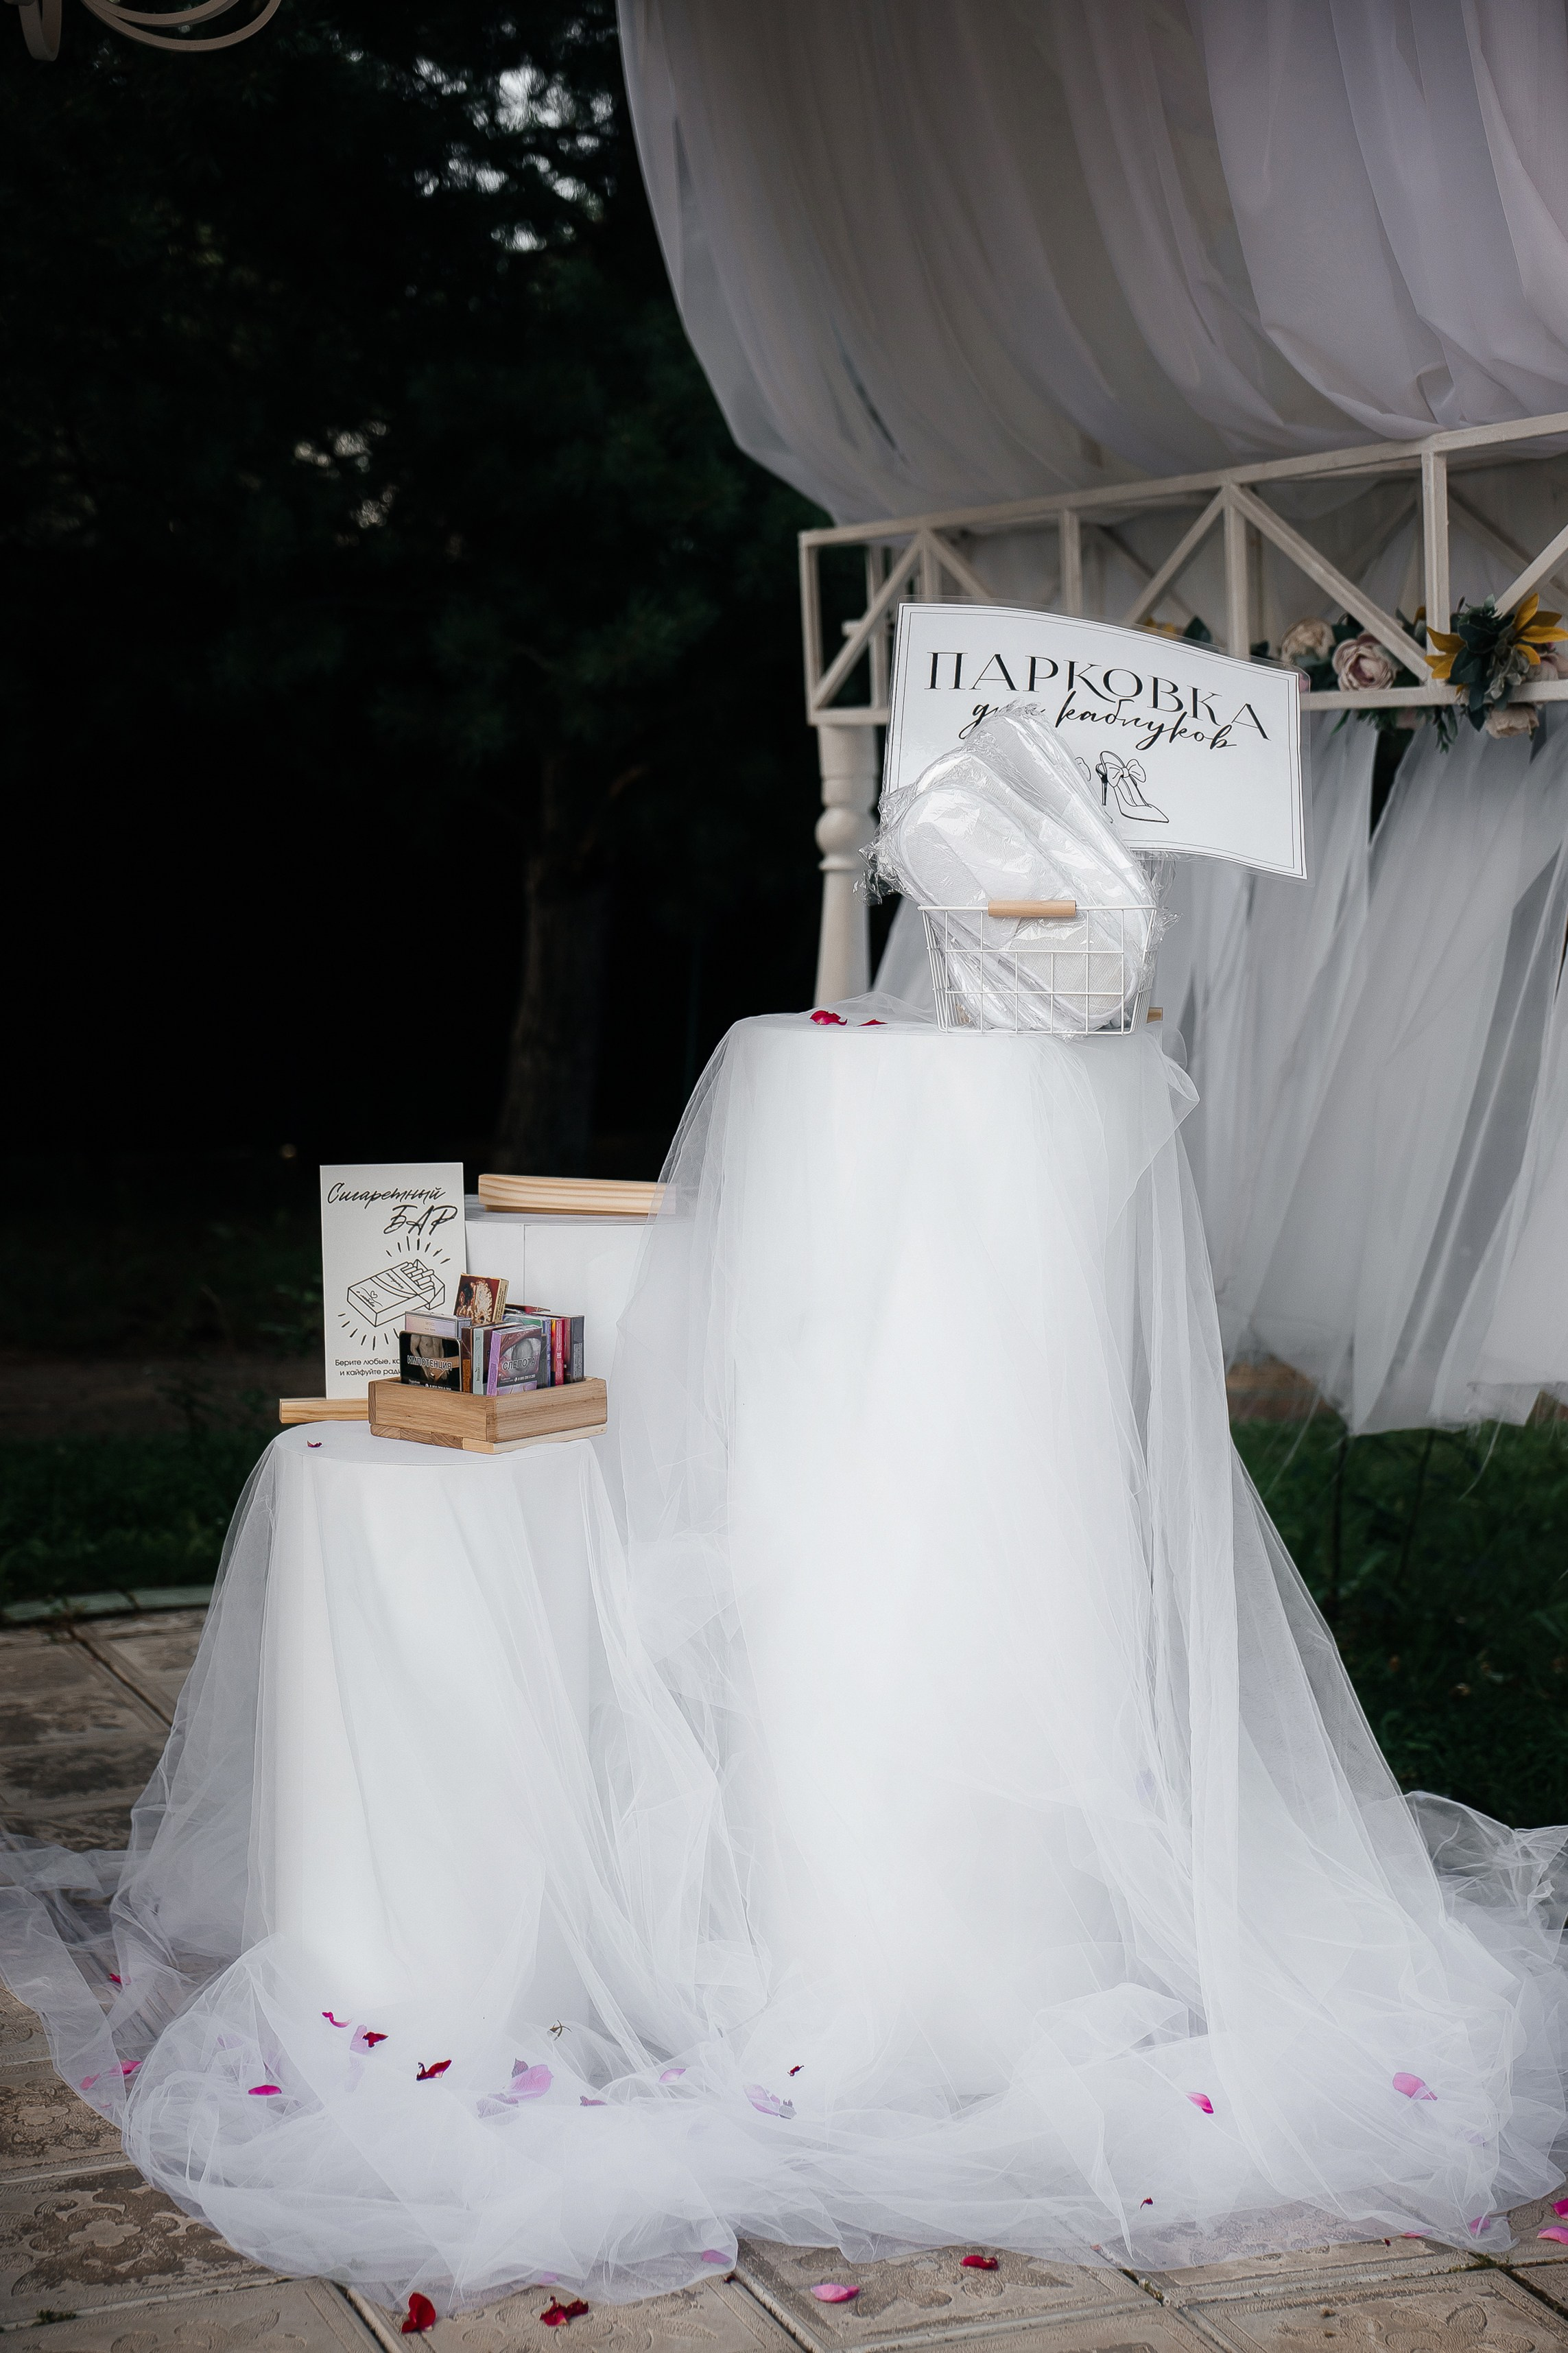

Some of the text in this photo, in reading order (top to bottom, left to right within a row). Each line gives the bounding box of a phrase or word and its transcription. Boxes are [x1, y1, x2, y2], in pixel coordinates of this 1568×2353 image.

[924, 651, 1272, 742] ПАРКОВКА
[1055, 690, 1237, 751] каблуков
[327, 1182, 447, 1210] Сигаретный
[383, 1204, 458, 1235] БАР
[335, 1359, 361, 1367] Берите
[363, 1358, 391, 1366] любые,
[346, 1369, 381, 1377] кайфуйте
[407, 1355, 453, 1371] ИМПОТЕНЦИЯ
[502, 1356, 536, 1371] СЛЕПОТА
